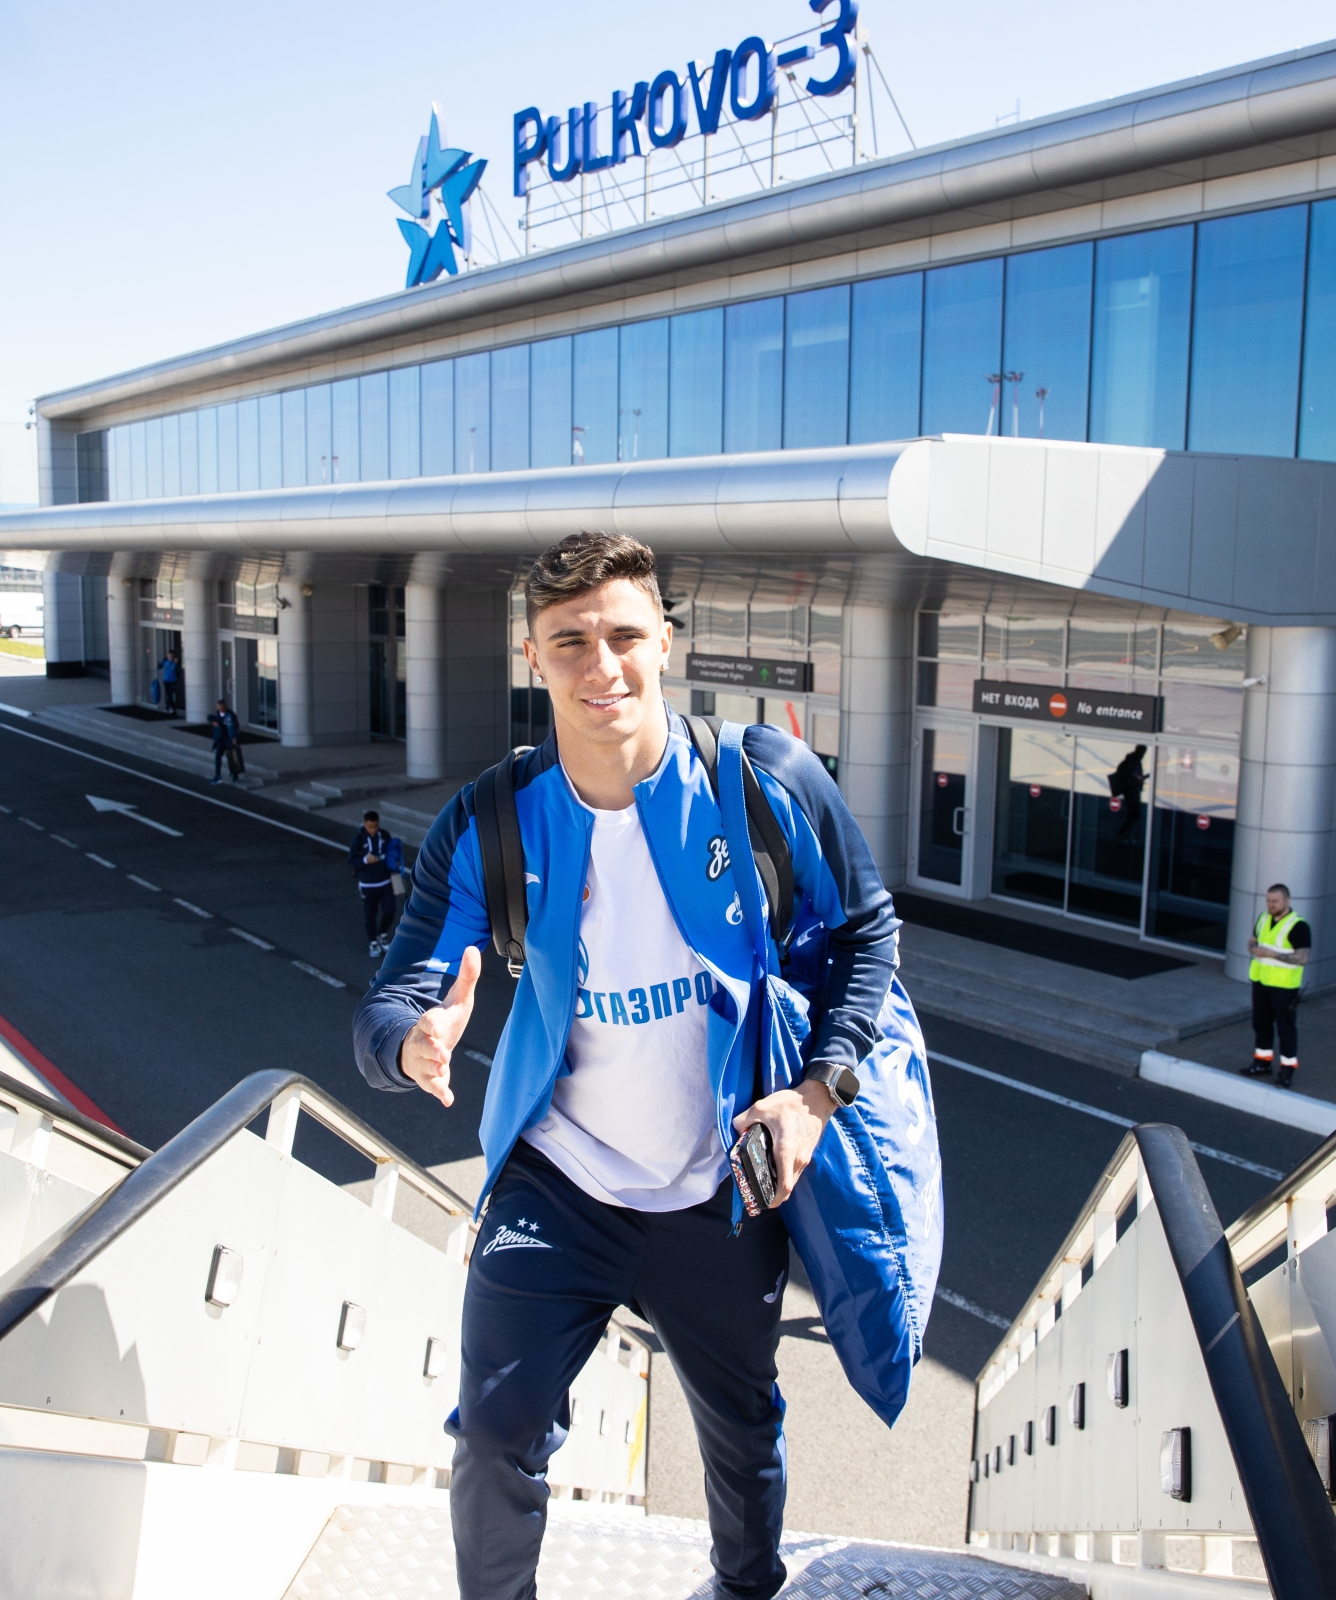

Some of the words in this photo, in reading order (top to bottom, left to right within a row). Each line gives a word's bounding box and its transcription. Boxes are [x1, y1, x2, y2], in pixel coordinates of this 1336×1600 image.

[513, 0, 858, 198] PULKOVO-3
[981, 692, 1001, 704] НЕТ
[1004, 694, 1040, 710] ВХОДА
[1077, 702, 1092, 715] No
[1096, 705, 1143, 720] entrance
[593, 970, 721, 1026] ГАЗПРО
